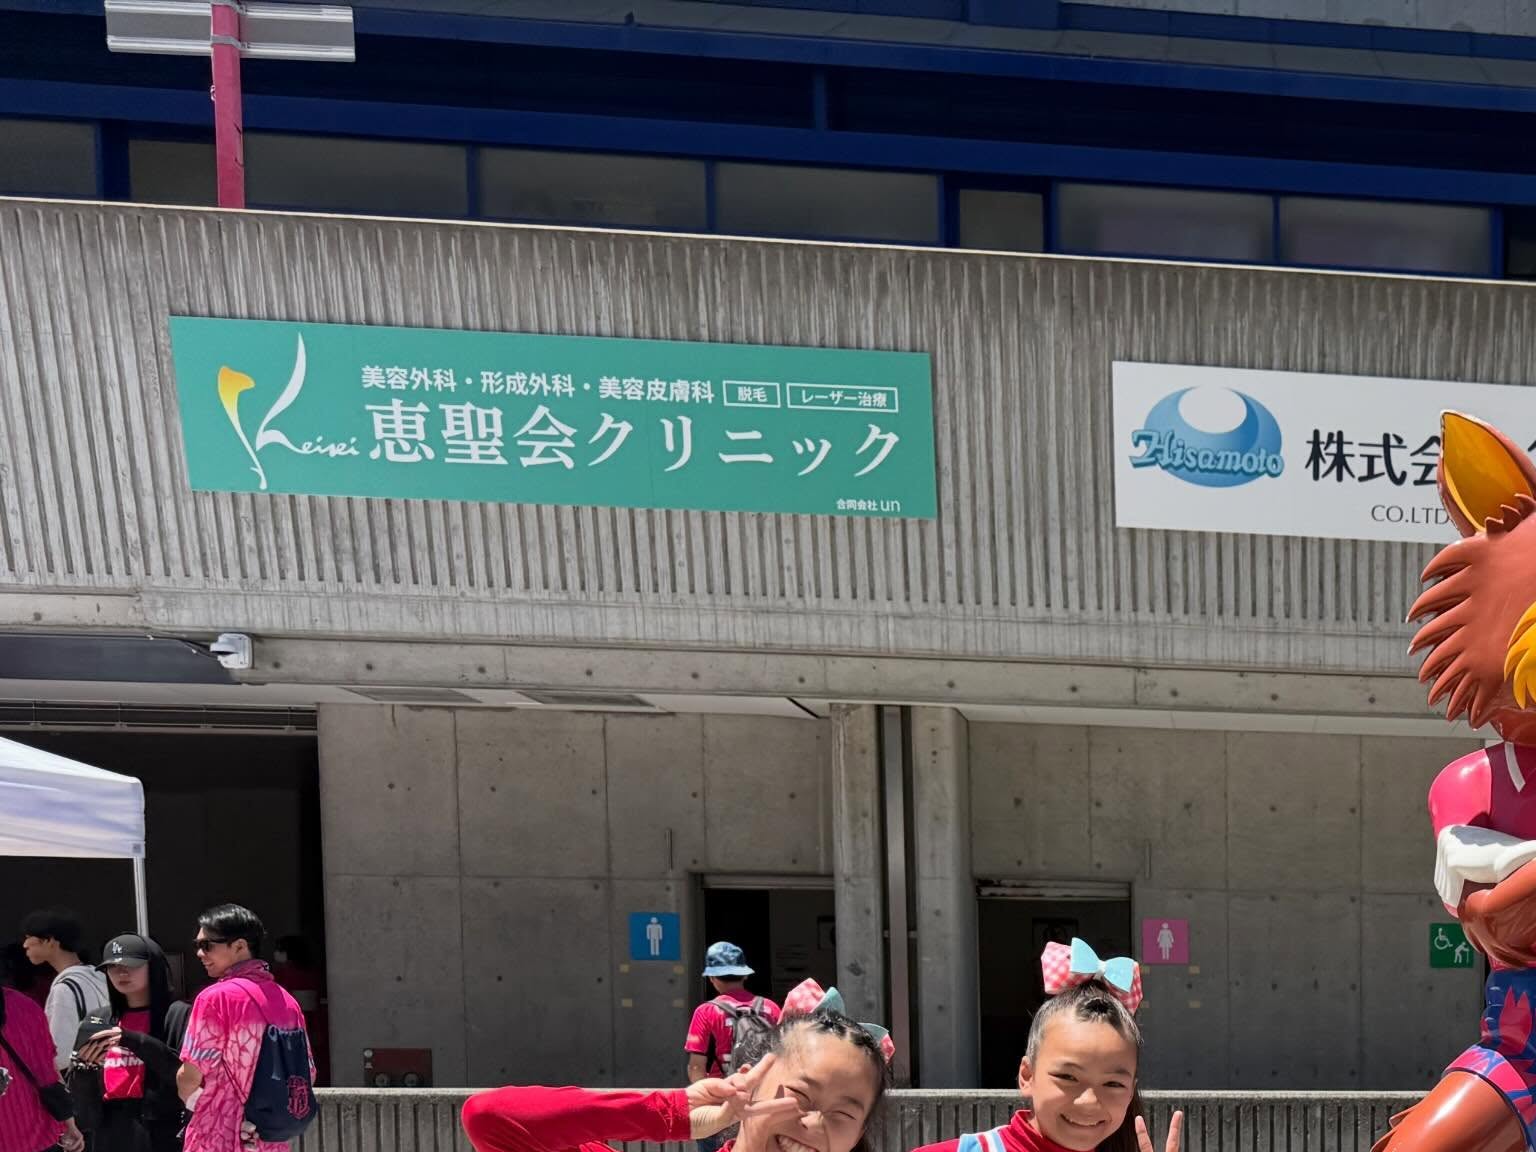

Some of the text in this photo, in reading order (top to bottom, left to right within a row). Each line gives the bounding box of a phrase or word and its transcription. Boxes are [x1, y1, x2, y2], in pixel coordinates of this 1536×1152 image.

[361, 365, 888, 408] 美容外科・形成外科・美容皮膚科 脱毛 レーザー治療
[365, 398, 899, 477] 恵聖会クリニック
[1128, 429, 1285, 478] Hisamoto
